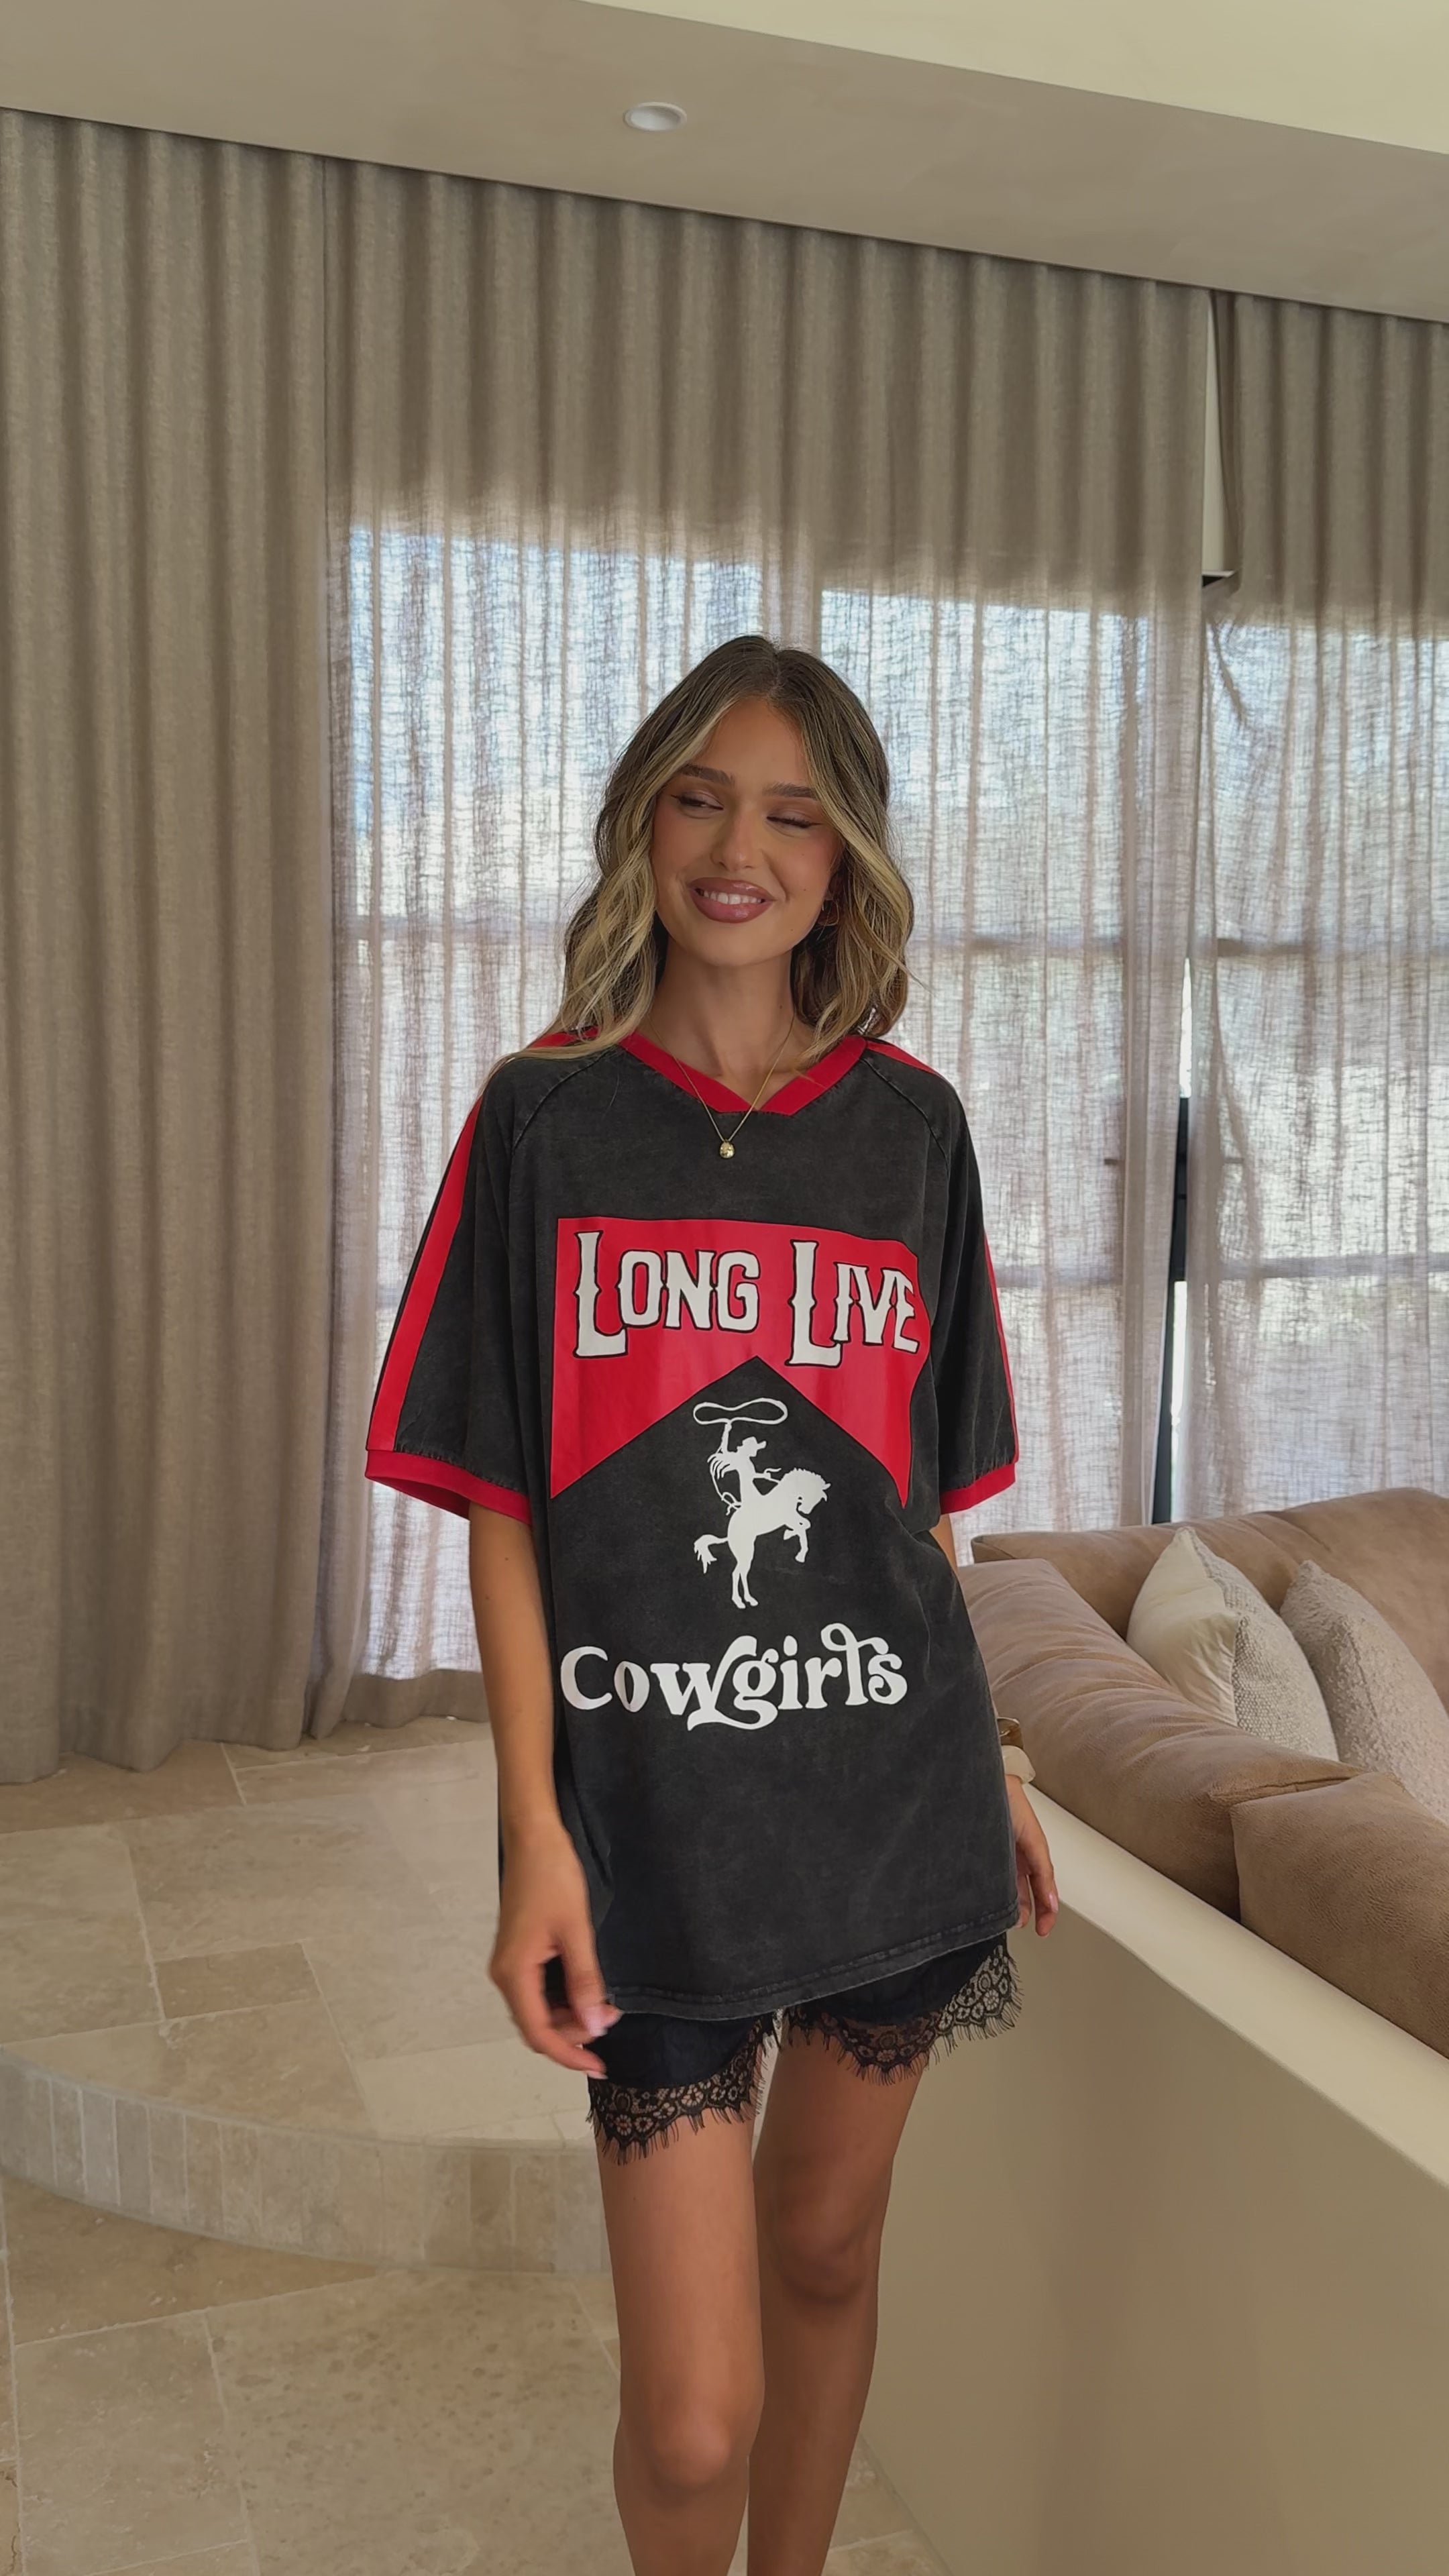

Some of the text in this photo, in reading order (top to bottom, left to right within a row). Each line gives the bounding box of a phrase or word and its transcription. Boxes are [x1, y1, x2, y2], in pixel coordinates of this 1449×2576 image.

[574, 1230, 920, 1368] LONG LIVE
[560, 1623, 908, 1731] Cowgirls
